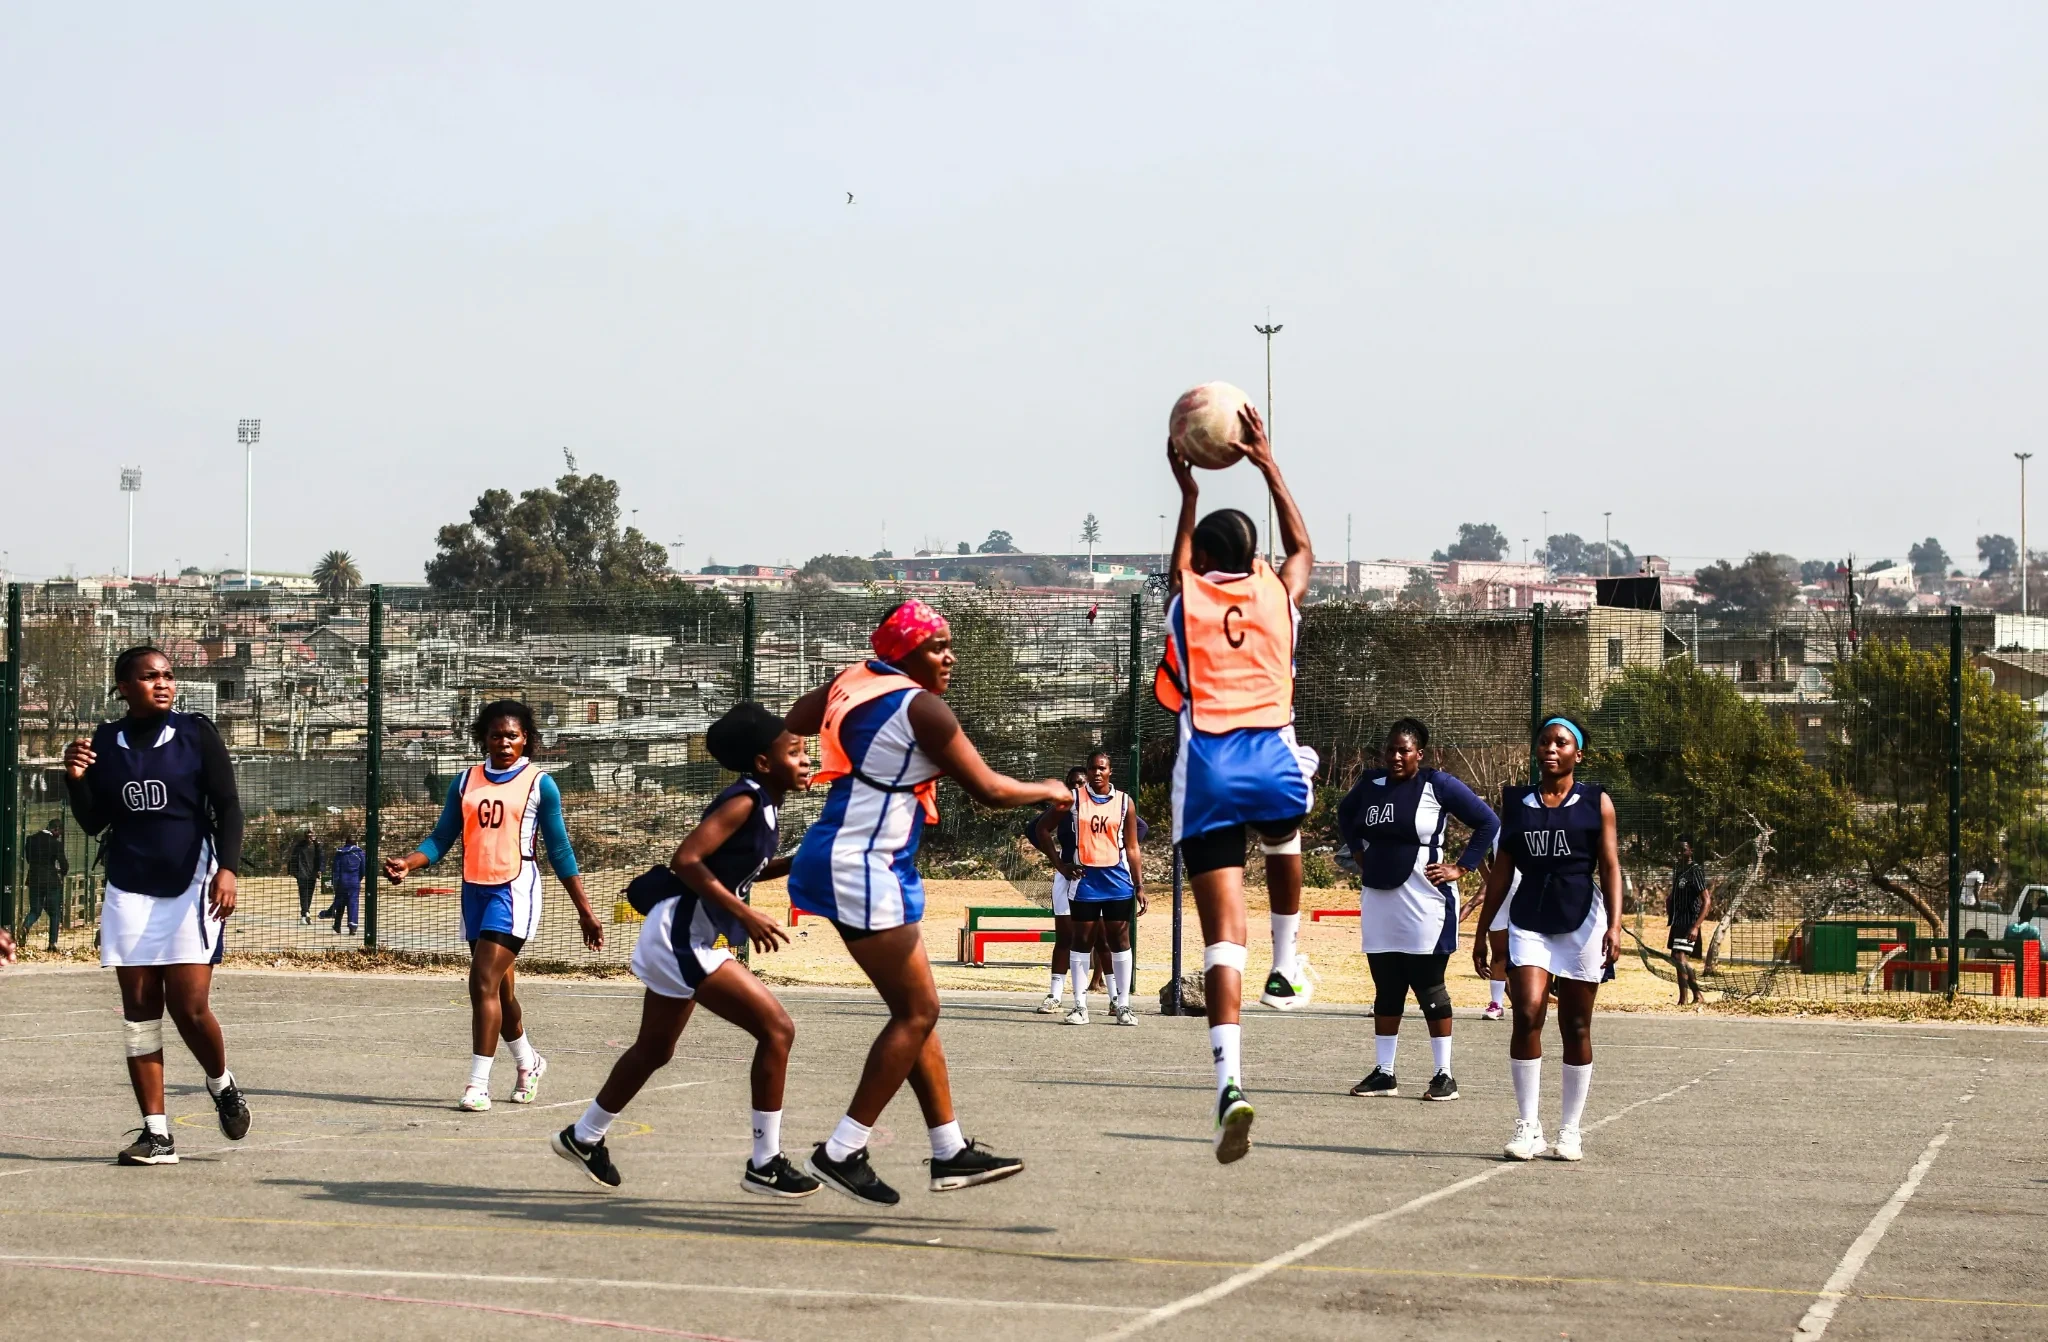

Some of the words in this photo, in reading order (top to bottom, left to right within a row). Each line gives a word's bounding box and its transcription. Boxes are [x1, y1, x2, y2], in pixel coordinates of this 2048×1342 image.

[1224, 605, 1245, 649] C
[122, 780, 168, 811] GD
[478, 799, 504, 829] GD
[1090, 815, 1109, 834] GK
[1365, 803, 1394, 826] GA
[1524, 830, 1571, 857] WA
